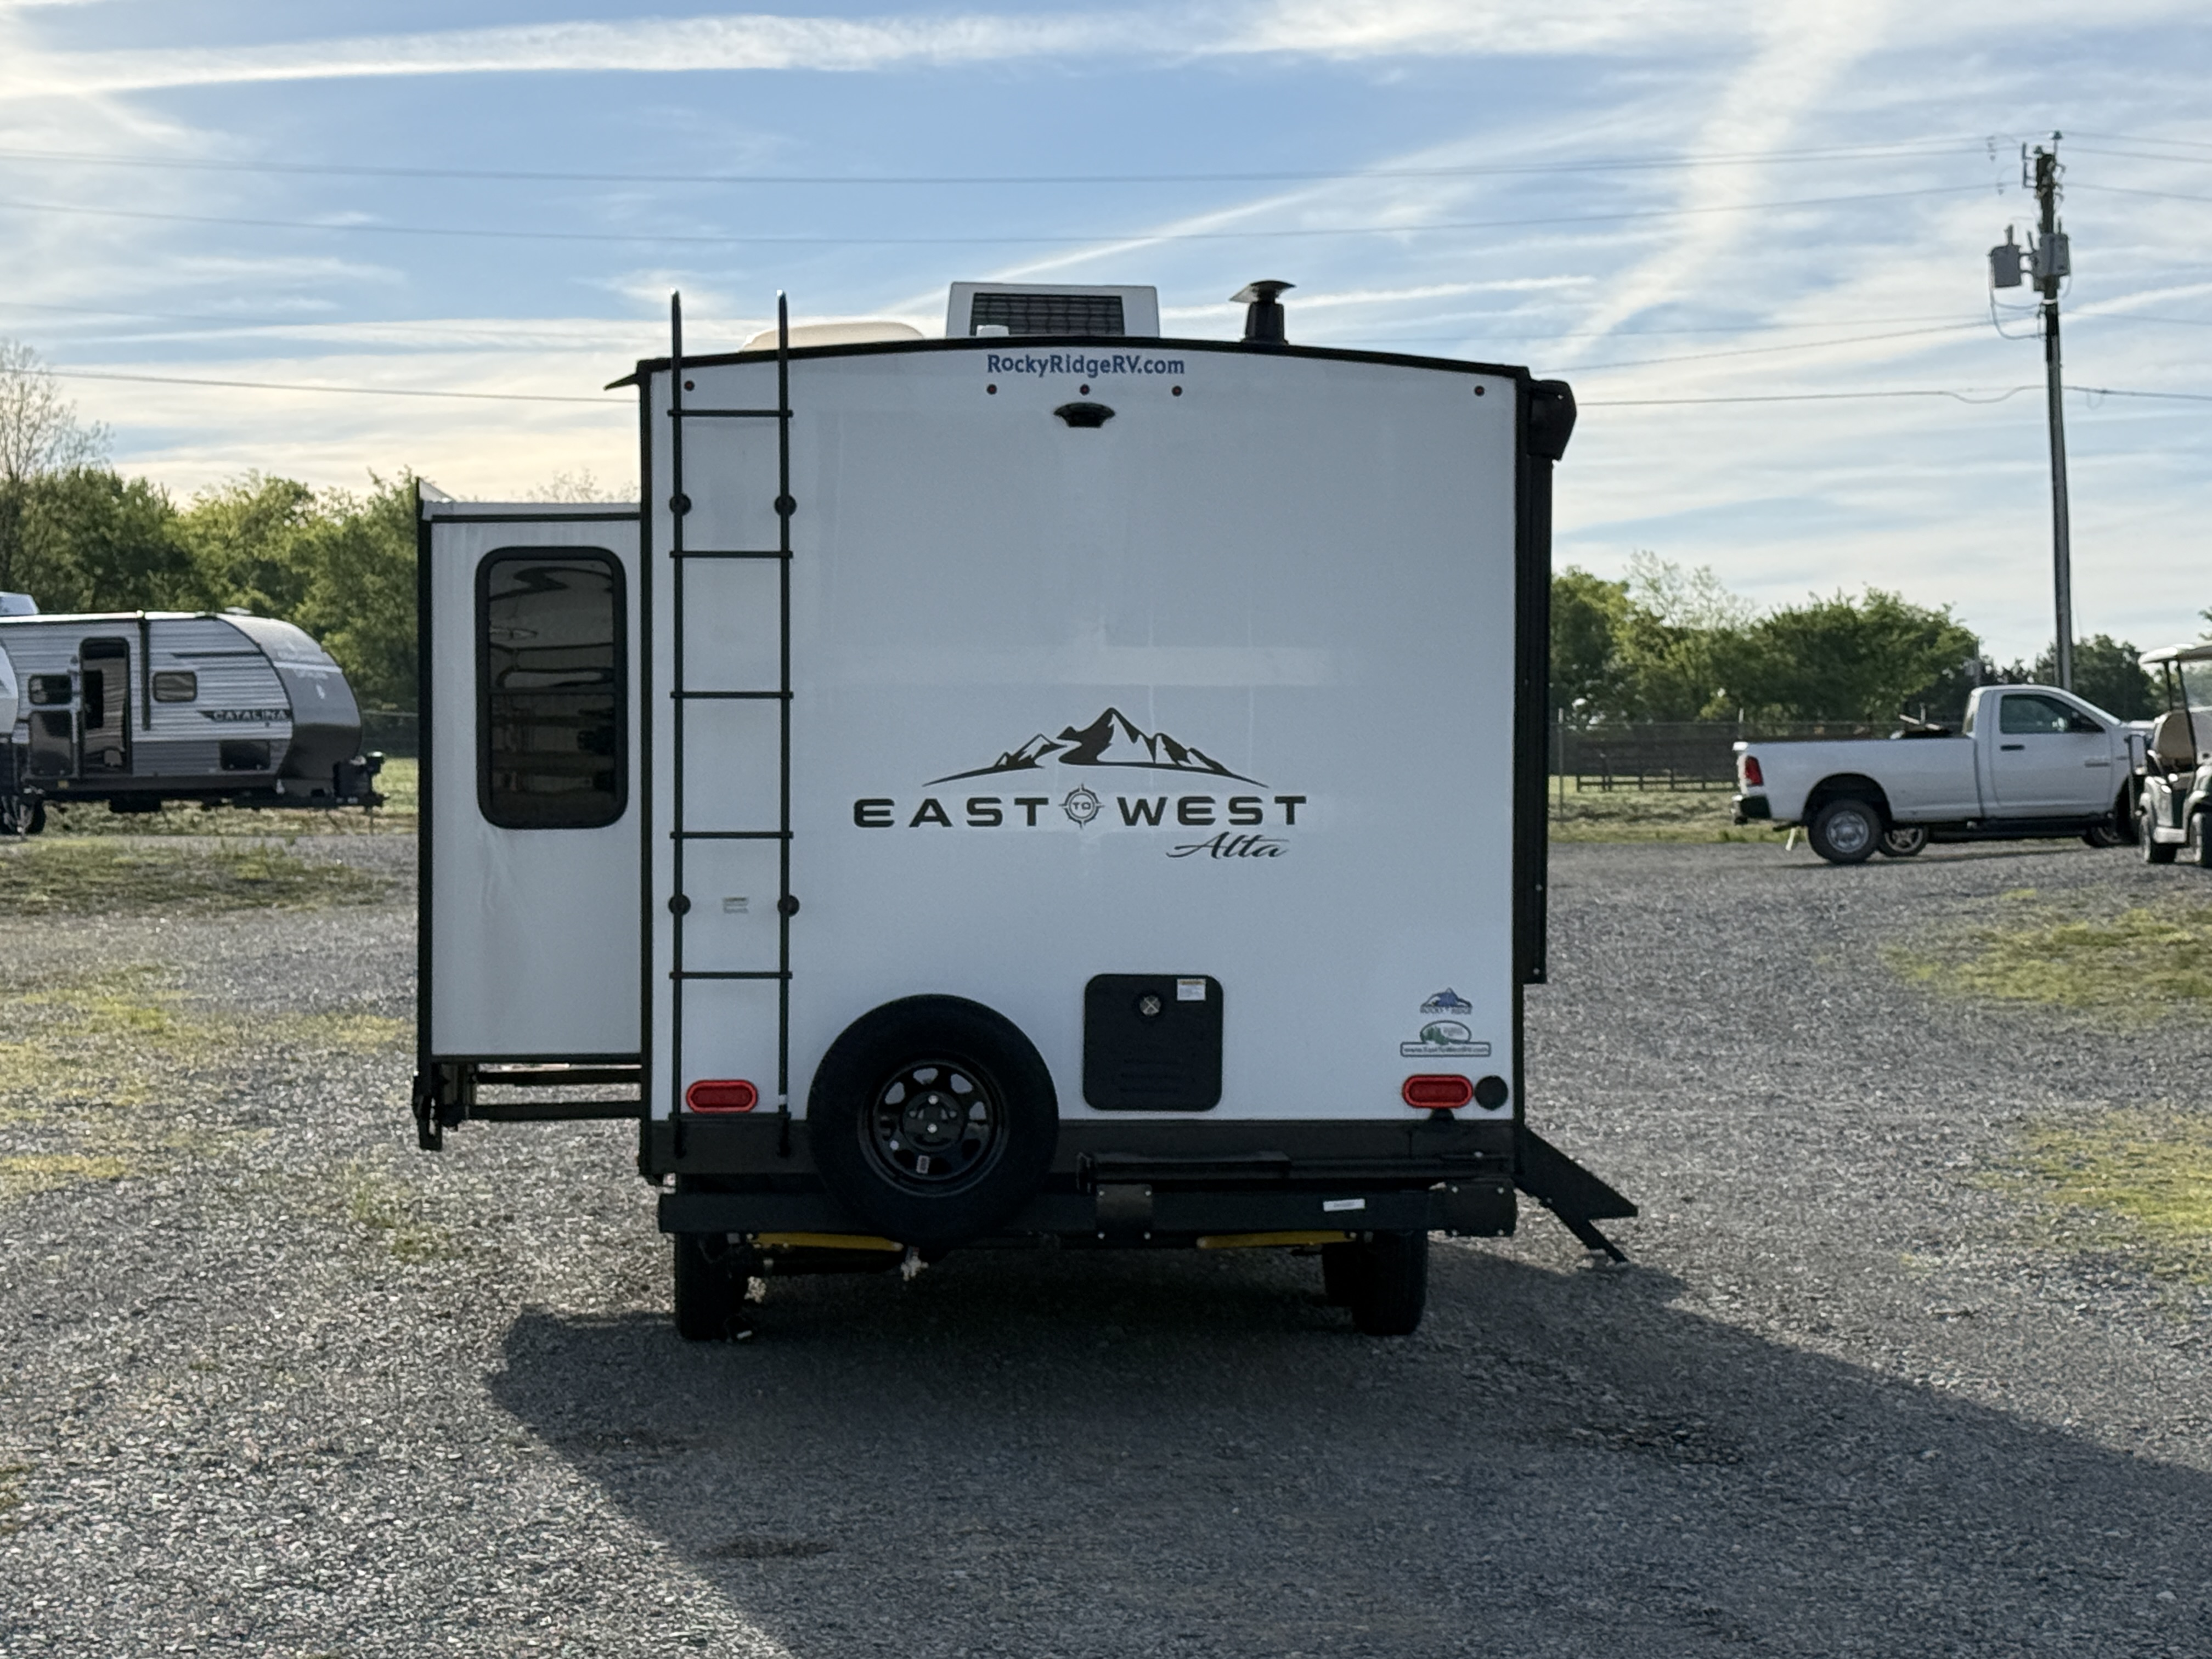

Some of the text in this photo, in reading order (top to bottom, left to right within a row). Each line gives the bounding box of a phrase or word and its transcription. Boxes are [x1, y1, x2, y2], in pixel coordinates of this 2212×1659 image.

[988, 354, 1185, 378] RockyRidgeRV.com
[213, 710, 286, 720] CATALINA
[854, 795, 1307, 828] EAST TO WEST
[1166, 831, 1289, 859] Alta
